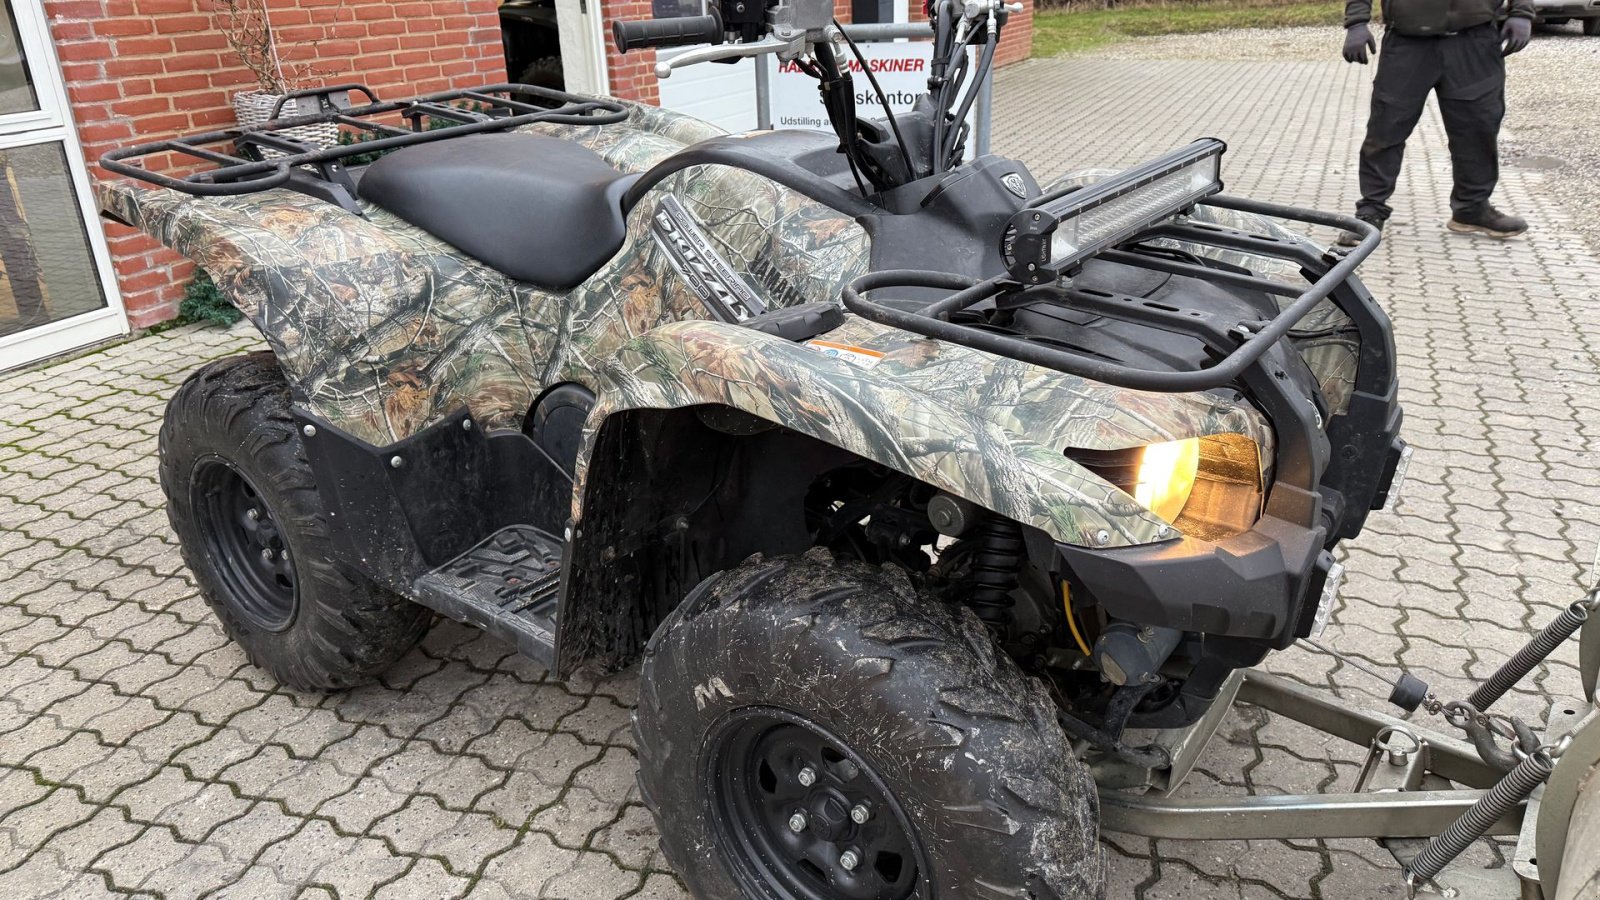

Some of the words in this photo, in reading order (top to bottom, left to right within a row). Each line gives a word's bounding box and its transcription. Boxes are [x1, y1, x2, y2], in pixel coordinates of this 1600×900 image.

[780, 117, 821, 127] Udstilling
[679, 263, 710, 299] 700
[703, 248, 750, 300] STEERING
